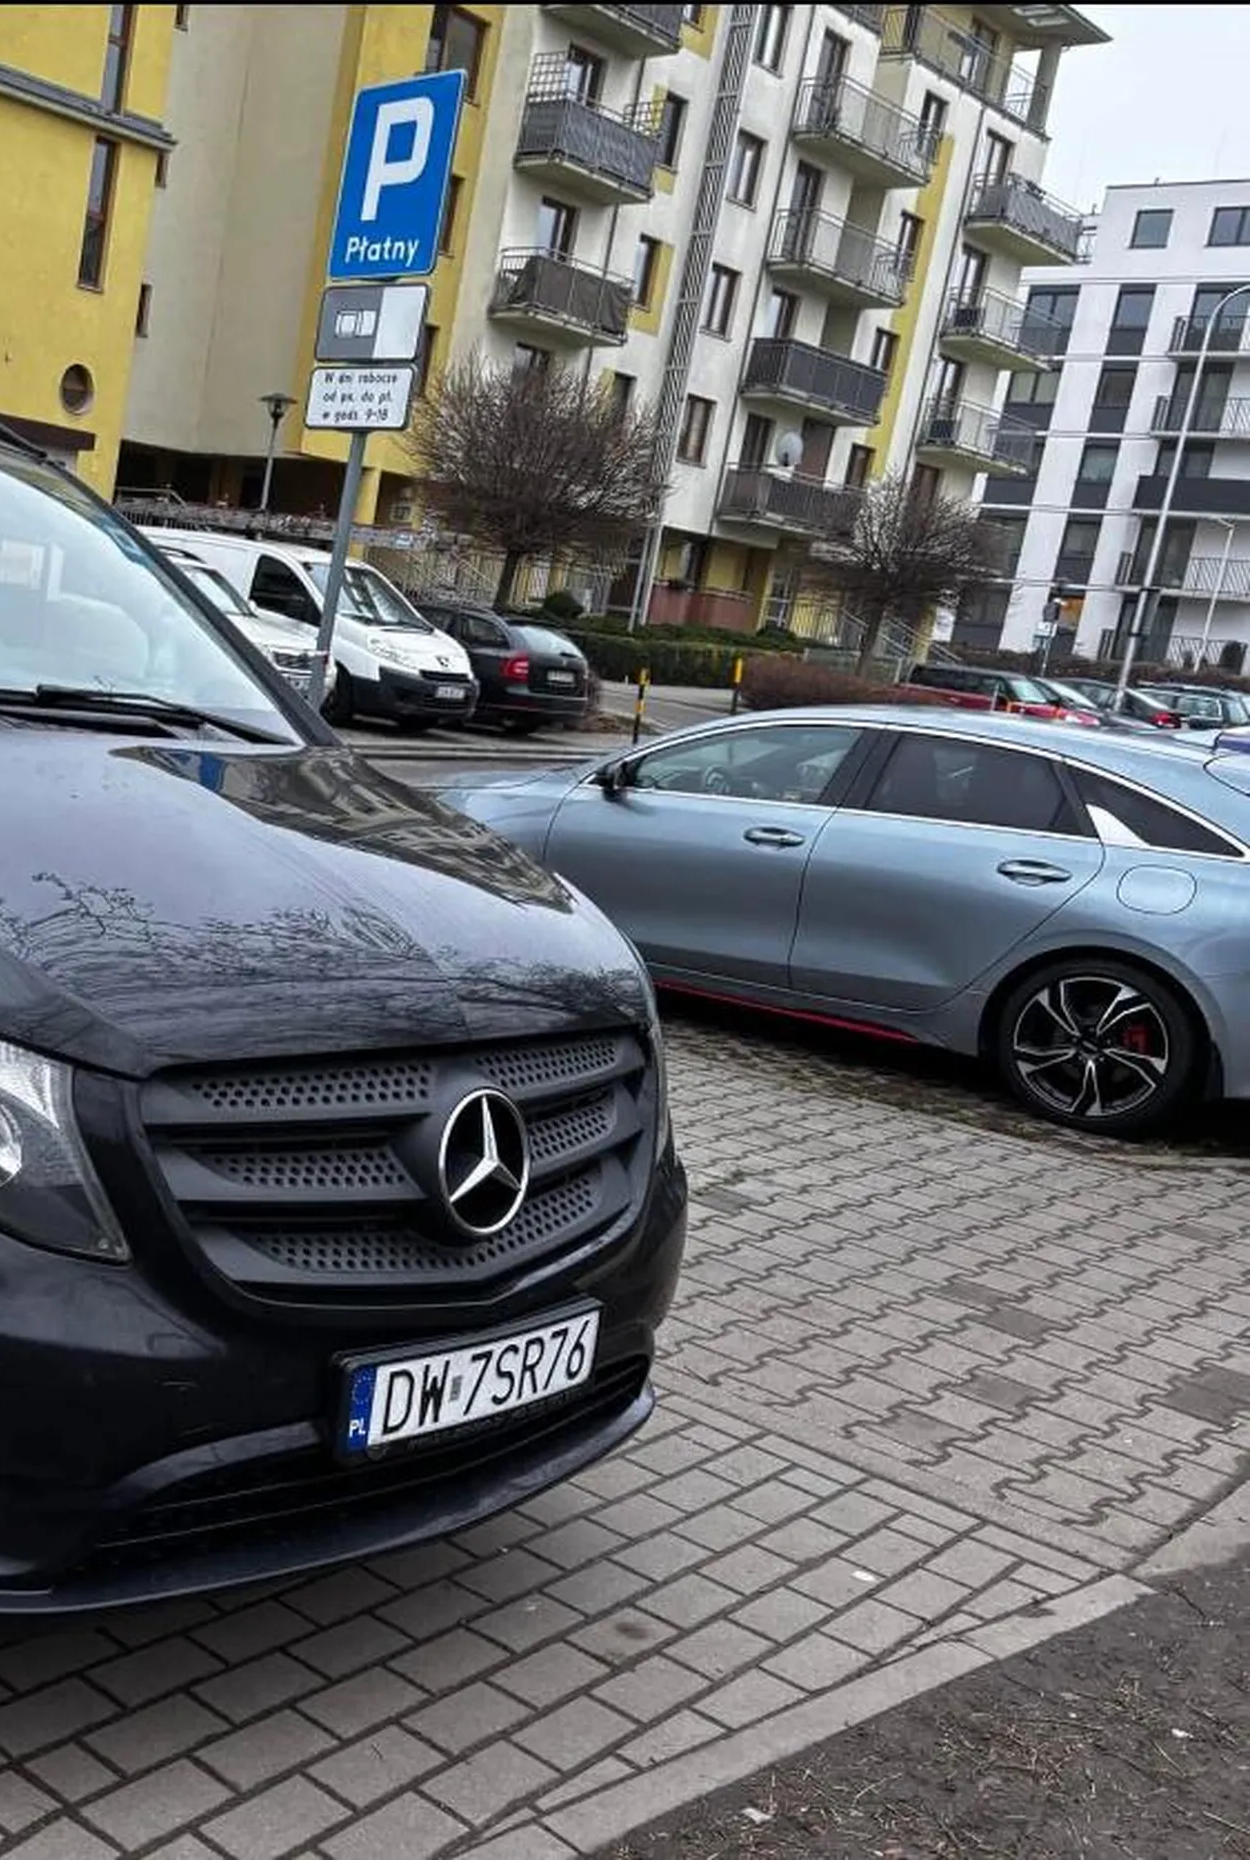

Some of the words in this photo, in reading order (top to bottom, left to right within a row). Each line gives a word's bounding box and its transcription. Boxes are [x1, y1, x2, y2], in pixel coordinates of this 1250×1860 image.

[360, 96, 435, 222] P
[345, 235, 419, 267] Płatny
[381, 1359, 450, 1436] DW
[462, 1319, 590, 1416] 7SR76
[349, 1419, 366, 1438] PL
